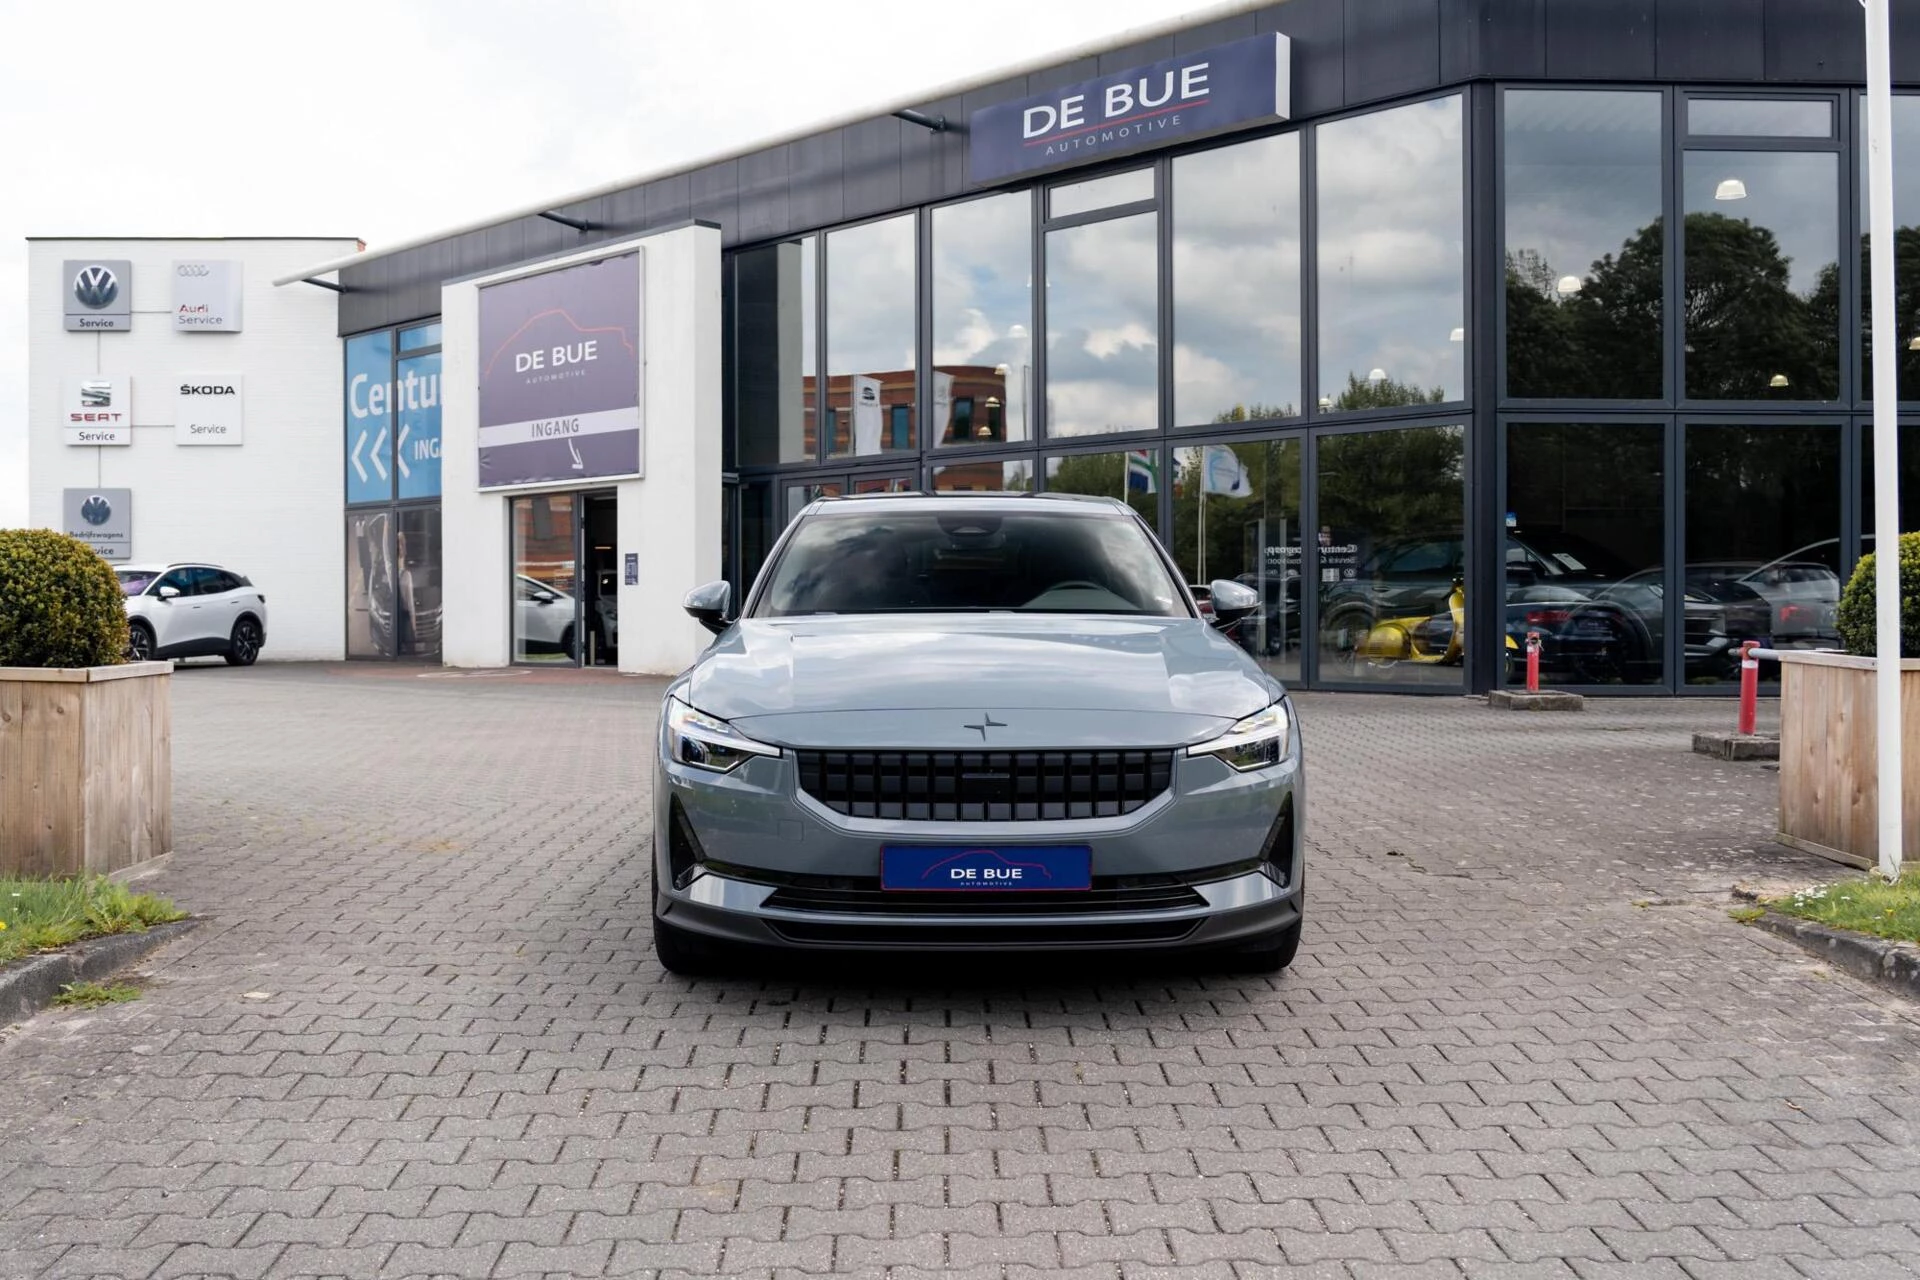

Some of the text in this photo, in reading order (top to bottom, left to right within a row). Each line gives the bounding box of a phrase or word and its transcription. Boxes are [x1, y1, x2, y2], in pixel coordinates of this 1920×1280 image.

[1022, 62, 1210, 139] DE BUE
[1045, 114, 1181, 157] AUTOMOTIVE
[178, 304, 209, 314] Audi
[79, 318, 115, 328] Service
[178, 315, 223, 325] Service
[515, 340, 598, 373] DE BUE
[525, 369, 586, 385] AUTOMOTIVE
[179, 384, 236, 396] ŠKODA
[350, 369, 442, 418] Centu
[70, 413, 122, 422] SEAT
[190, 424, 226, 434] Service
[531, 418, 580, 438] INGANG
[78, 431, 116, 441] Service
[414, 437, 442, 461] ING
[93, 546, 114, 555] vice
[951, 868, 1023, 880] DE BUE
